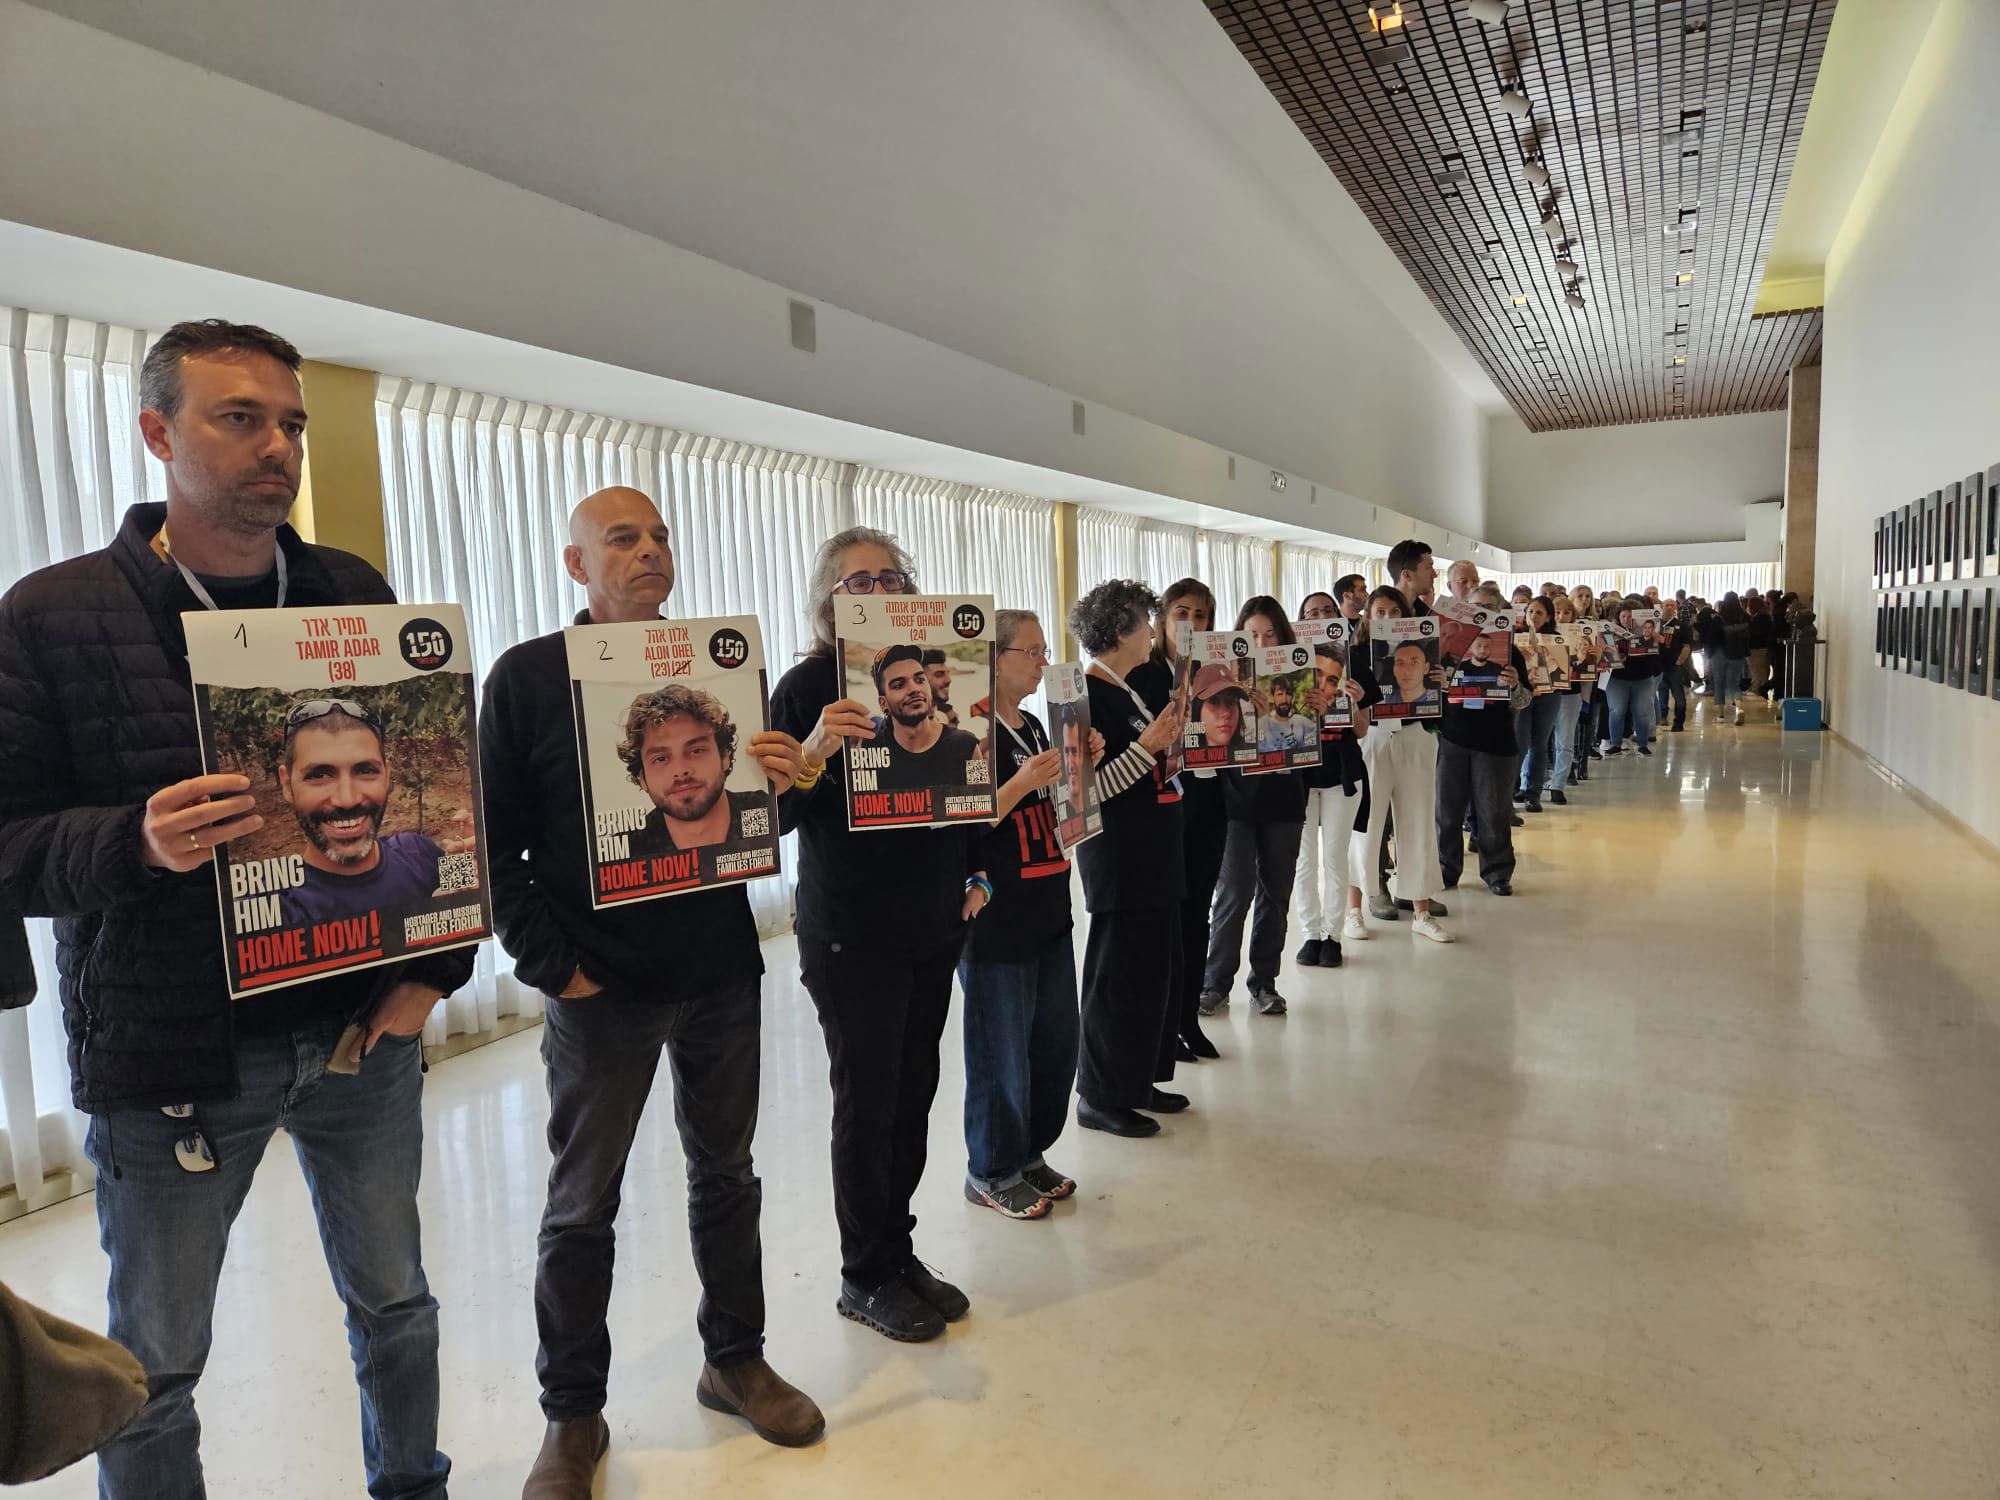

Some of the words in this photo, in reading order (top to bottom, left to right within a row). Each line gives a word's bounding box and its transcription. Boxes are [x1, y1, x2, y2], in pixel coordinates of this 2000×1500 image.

[852, 604, 867, 624] 3
[911, 601, 929, 613] חיים
[930, 601, 947, 613] יוסף
[302, 618, 331, 638] אדר
[333, 616, 367, 636] תמיר
[890, 615, 915, 627] YOSEF
[916, 614, 944, 627] OHANA
[957, 613, 980, 631] 150
[234, 623, 247, 648] 1
[645, 628, 667, 644] אהל
[668, 627, 689, 644] אלון
[910, 628, 926, 641] (24)
[1328, 627, 1342, 636] 150
[296, 640, 340, 660] TAMIR
[344, 638, 381, 657] ADAR
[405, 631, 445, 658] 150
[597, 640, 613, 661] 2
[645, 645, 670, 661] ALON
[672, 643, 696, 659] OHEL
[716, 637, 744, 660] 150
[1235, 642, 1247, 653] 150
[329, 661, 356, 682] (38)
[1184, 722, 1206, 735] BRING
[1184, 735, 1200, 748] HER
[850, 747, 891, 769] BRING
[852, 770, 878, 792] HIM
[854, 793, 892, 816] HOME
[894, 788, 932, 815] NOW!
[595, 807, 647, 837] BRING
[597, 835, 630, 862] HIM
[229, 853, 305, 898] BRING
[600, 860, 648, 891] HOME
[651, 848, 699, 882] NOW!
[716, 859, 748, 877] FAMILIES
[749, 855, 774, 870] FORUM
[233, 894, 282, 934] HIM
[404, 912, 438, 928] HOSTAGES
[439, 909, 452, 920] AND
[405, 921, 448, 943] FAMILIES
[449, 914, 483, 933] FORUM
[238, 928, 308, 975] HOME
[312, 910, 382, 958] NOW!
